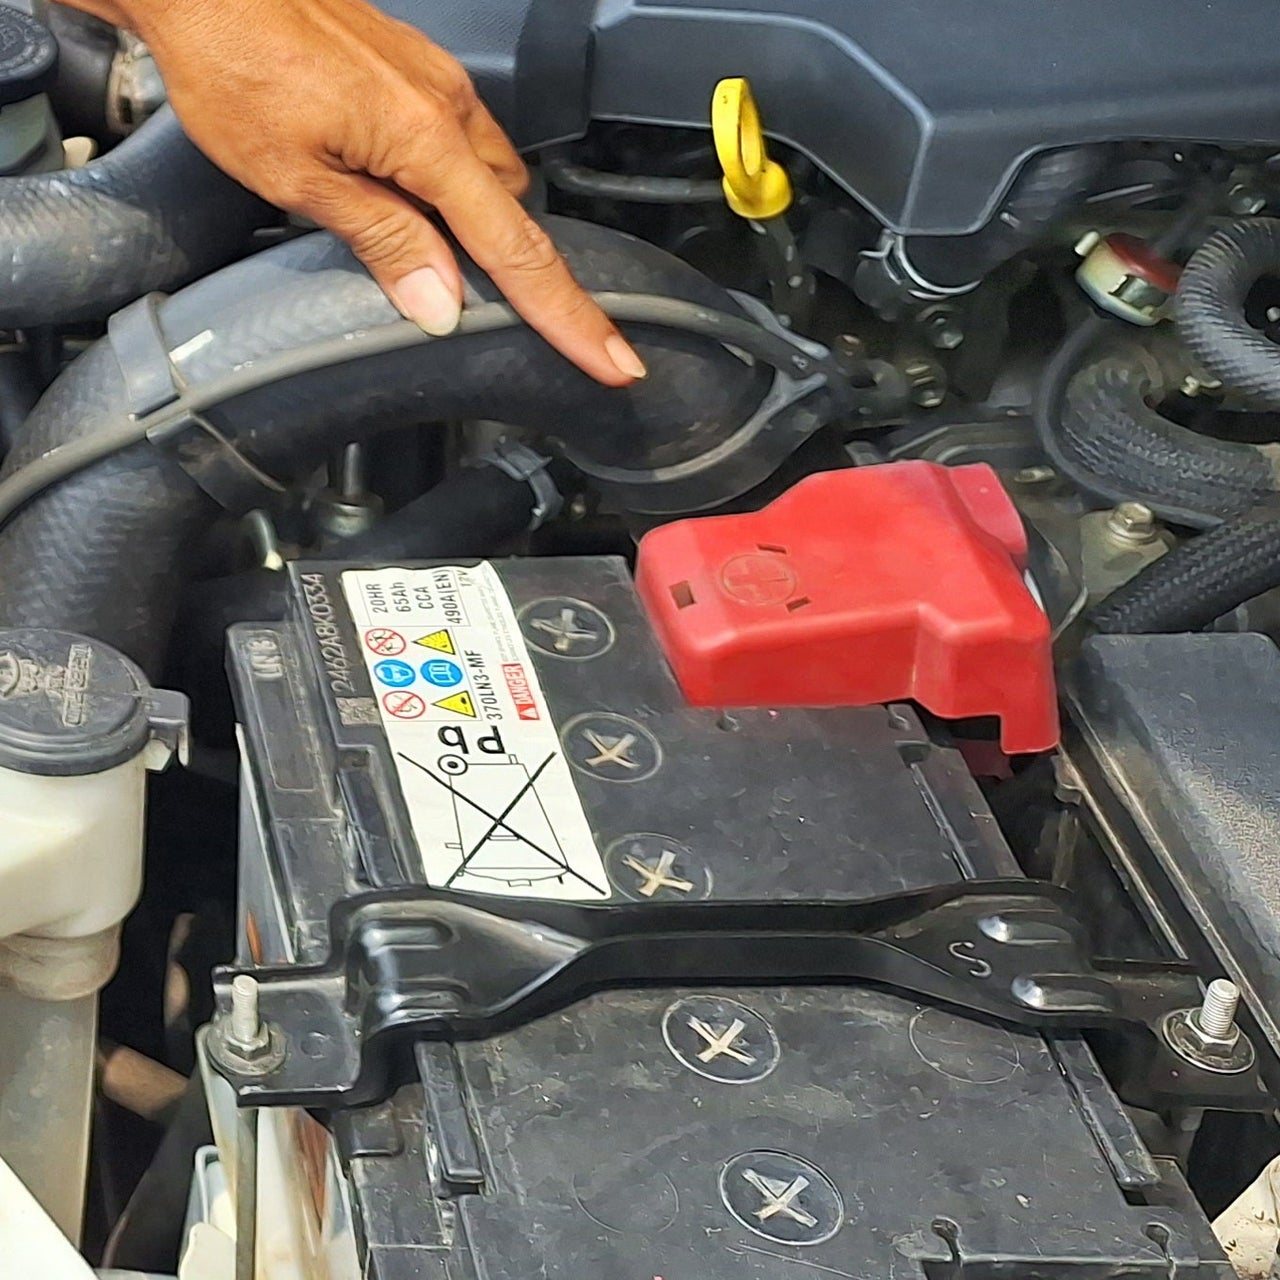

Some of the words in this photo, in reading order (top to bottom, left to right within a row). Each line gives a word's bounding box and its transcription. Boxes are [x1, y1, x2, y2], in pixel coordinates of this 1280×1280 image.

[365, 582, 389, 614] 20HR
[389, 581, 412, 613] 65Ah
[413, 585, 435, 610] CCA
[432, 568, 463, 625] 490A(EN)
[463, 649, 503, 721] 370LN3-MF
[501, 663, 535, 705] DANGER
